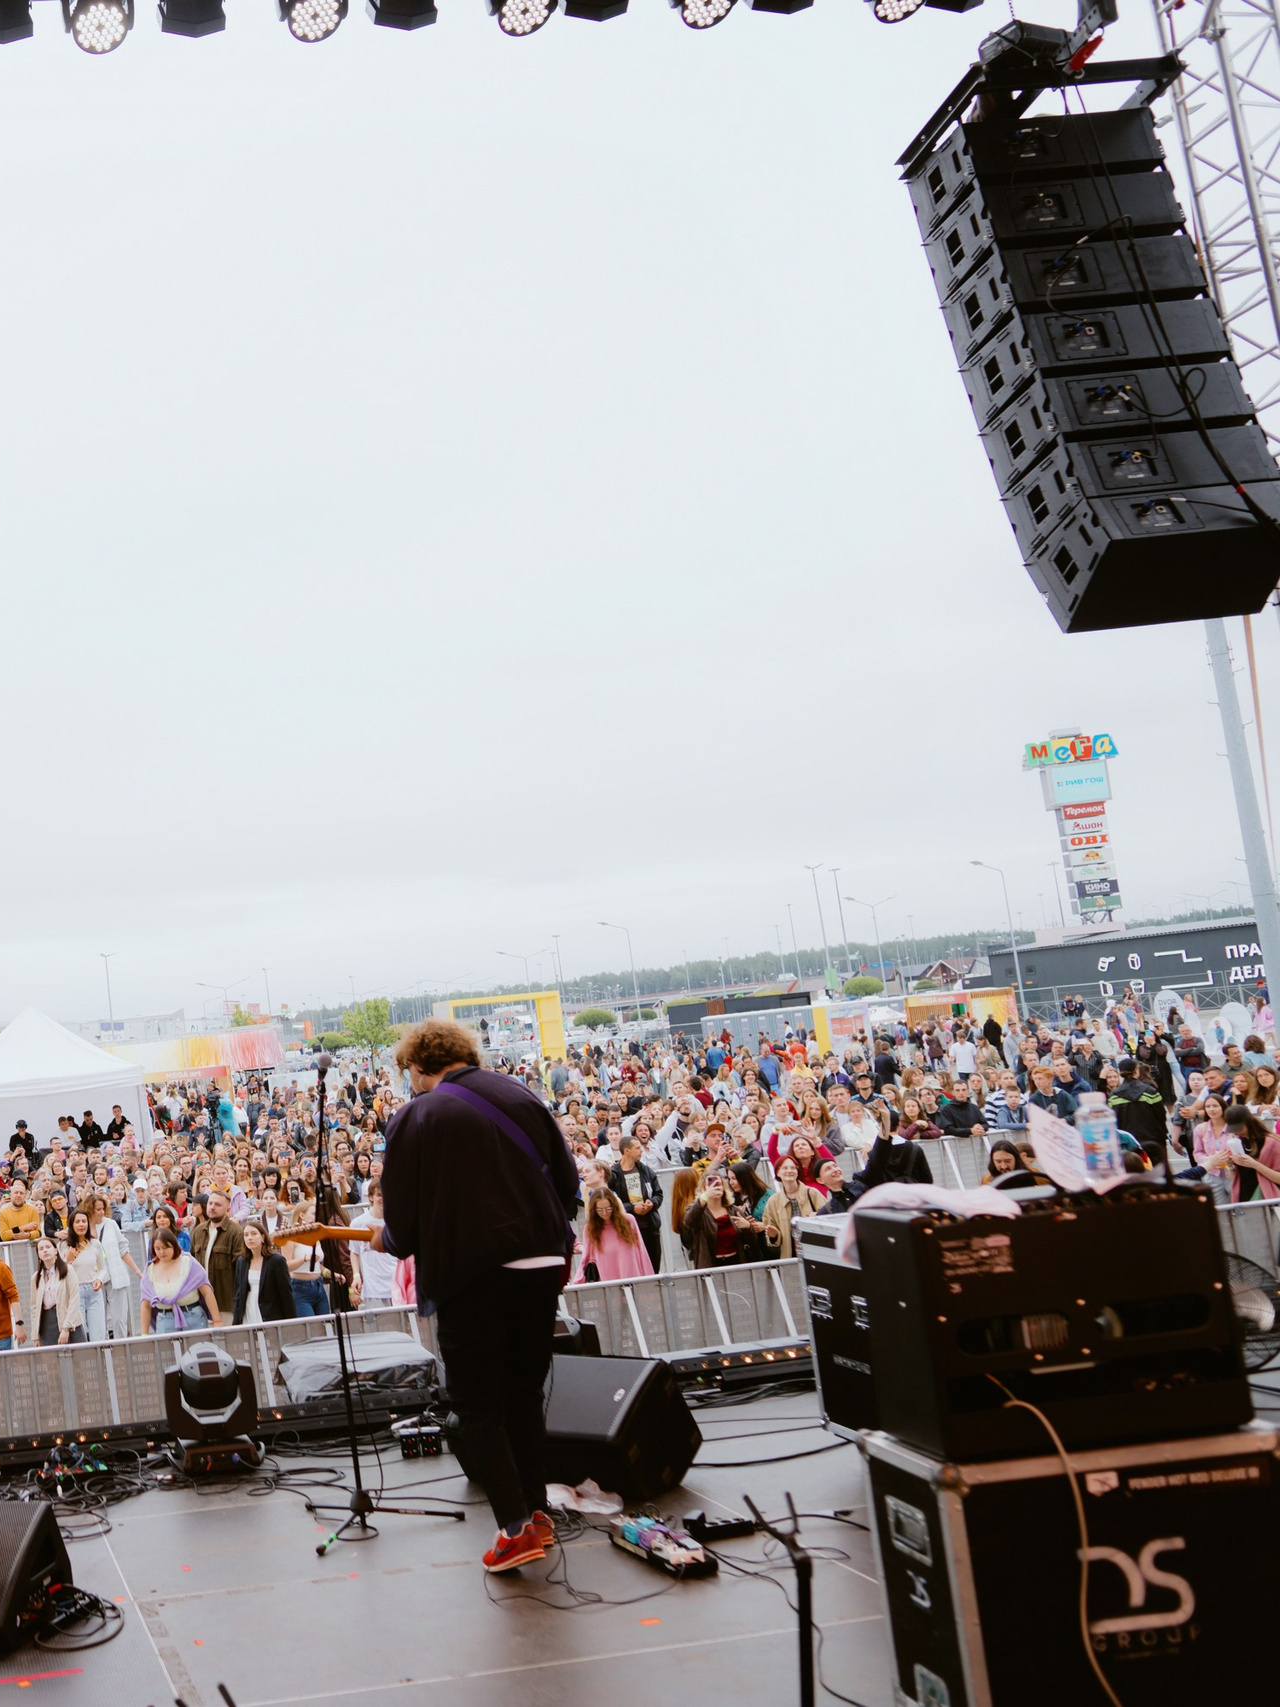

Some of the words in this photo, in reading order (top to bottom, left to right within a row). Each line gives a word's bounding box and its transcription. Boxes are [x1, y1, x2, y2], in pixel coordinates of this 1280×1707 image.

[1064, 805, 1104, 816] Теремок
[1070, 834, 1109, 846] OBI
[1085, 882, 1111, 892] КИНО
